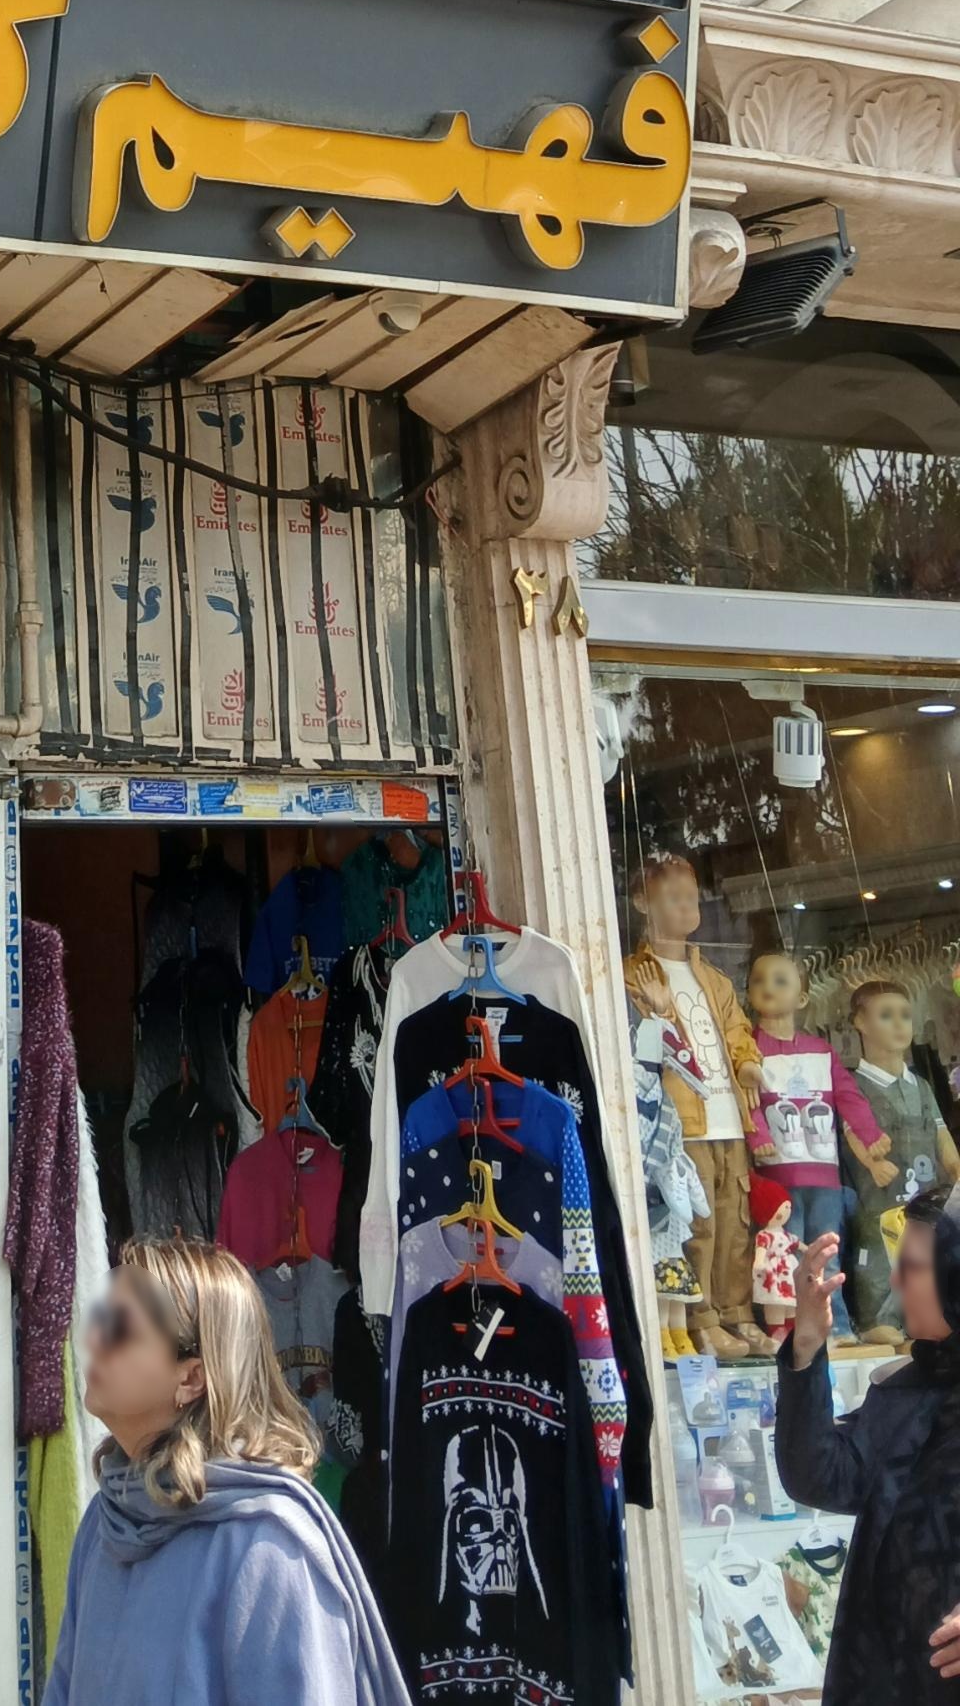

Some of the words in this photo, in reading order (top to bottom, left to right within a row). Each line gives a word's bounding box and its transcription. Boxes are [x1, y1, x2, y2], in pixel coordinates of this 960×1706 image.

[80, 14, 692, 271] فهیم
[281, 426, 342, 443] Emates
[116, 468, 152, 479] IraAir
[287, 520, 348, 536] Emates
[294, 620, 356, 637] Emates
[301, 713, 363, 730] Emates
